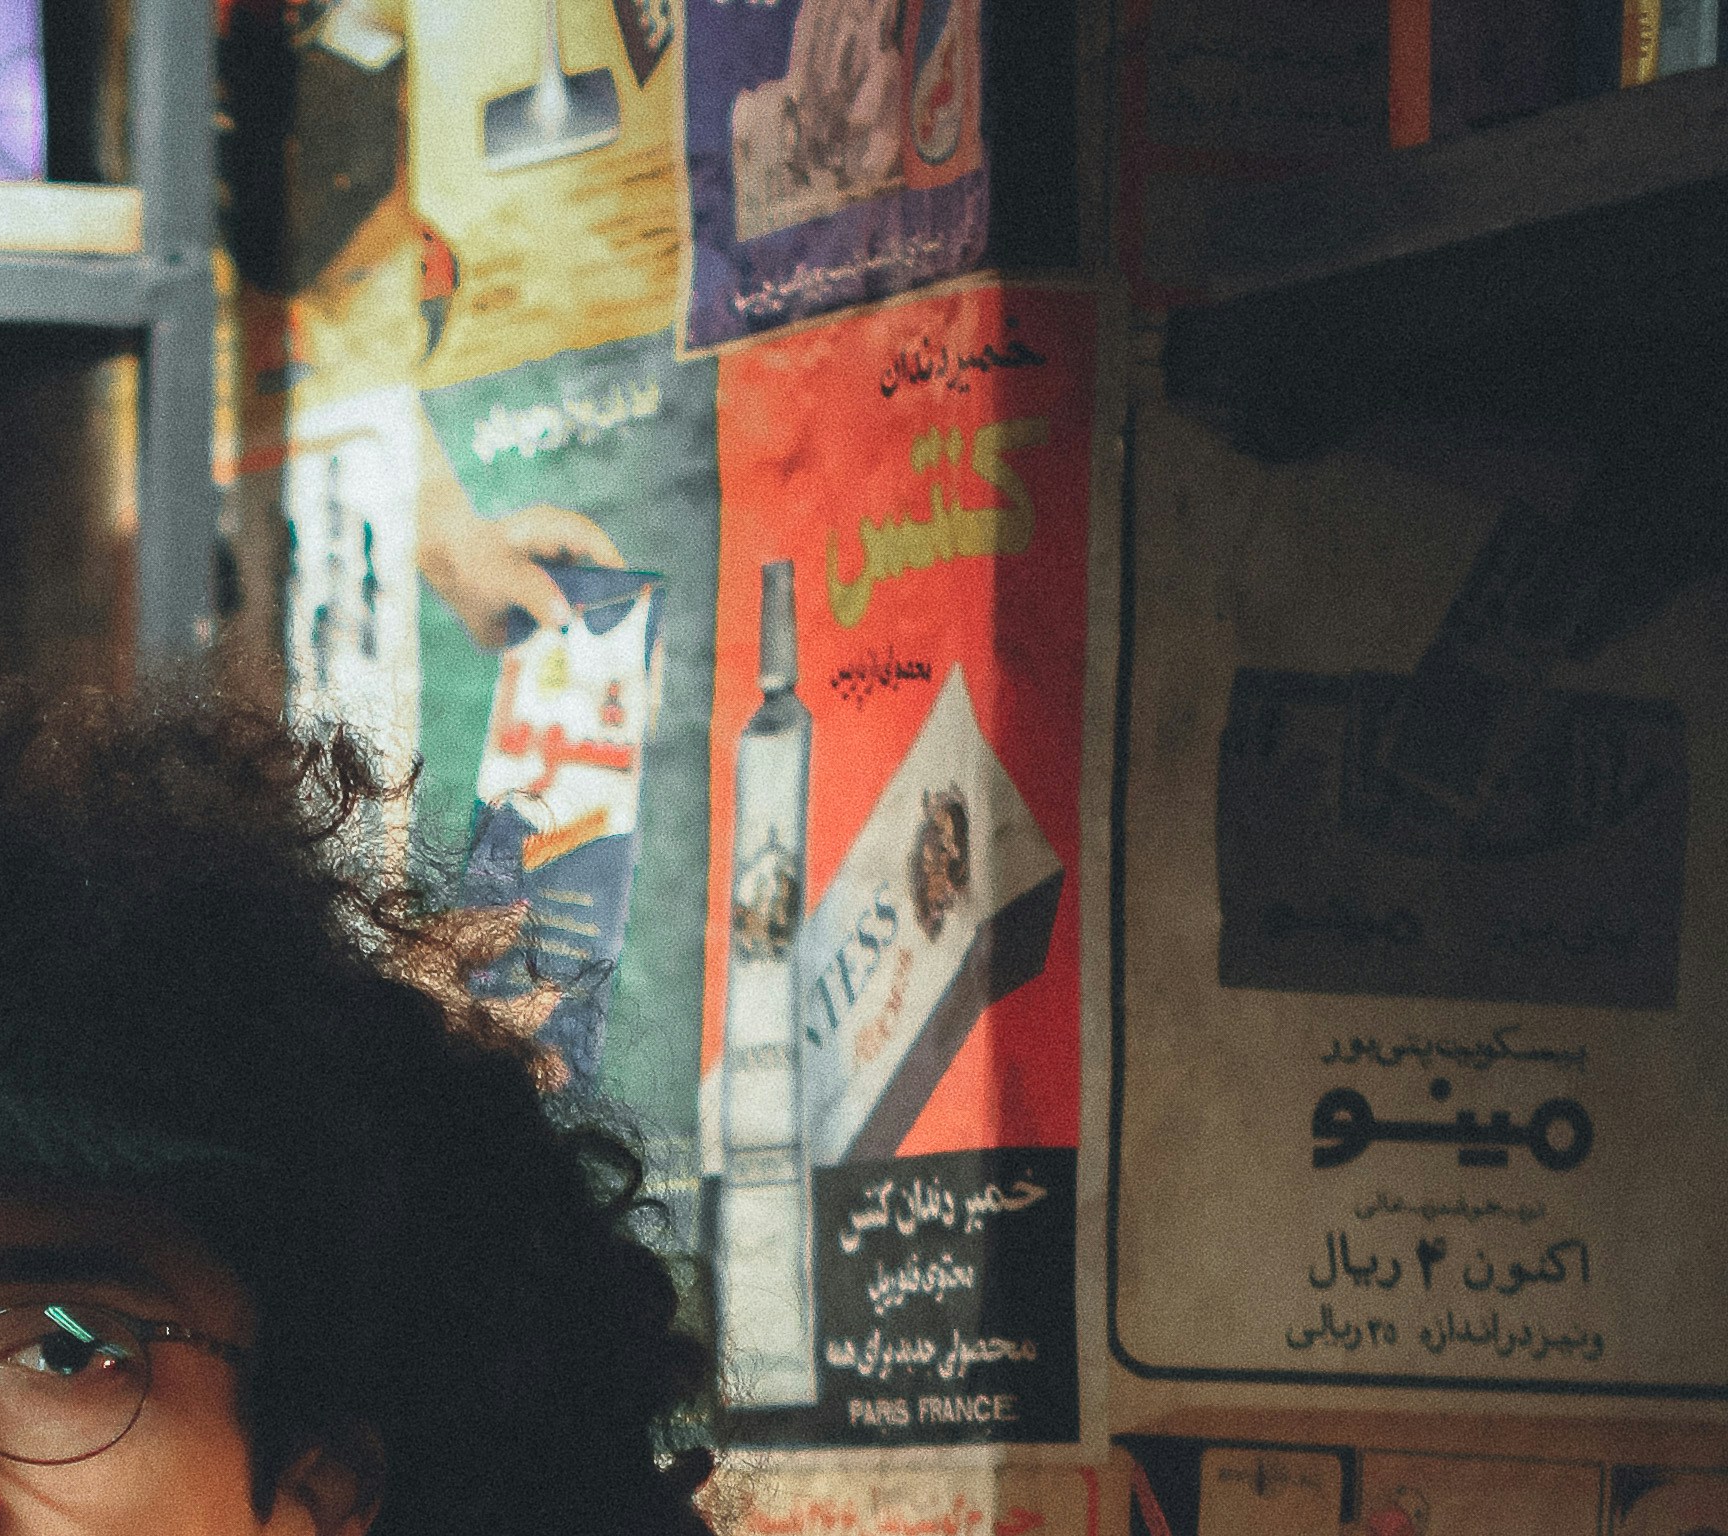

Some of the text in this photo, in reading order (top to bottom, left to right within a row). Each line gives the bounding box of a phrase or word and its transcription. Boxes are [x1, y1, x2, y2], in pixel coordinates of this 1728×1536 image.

[1311, 1076, 1594, 1172] مینو
[895, 1176, 956, 1237] دندان
[963, 1168, 1048, 1235] خمیر
[1308, 1230, 1402, 1290] ریال
[1462, 1238, 1590, 1296] اکنون
[848, 1394, 1021, 1427] PARIS FRANCE
